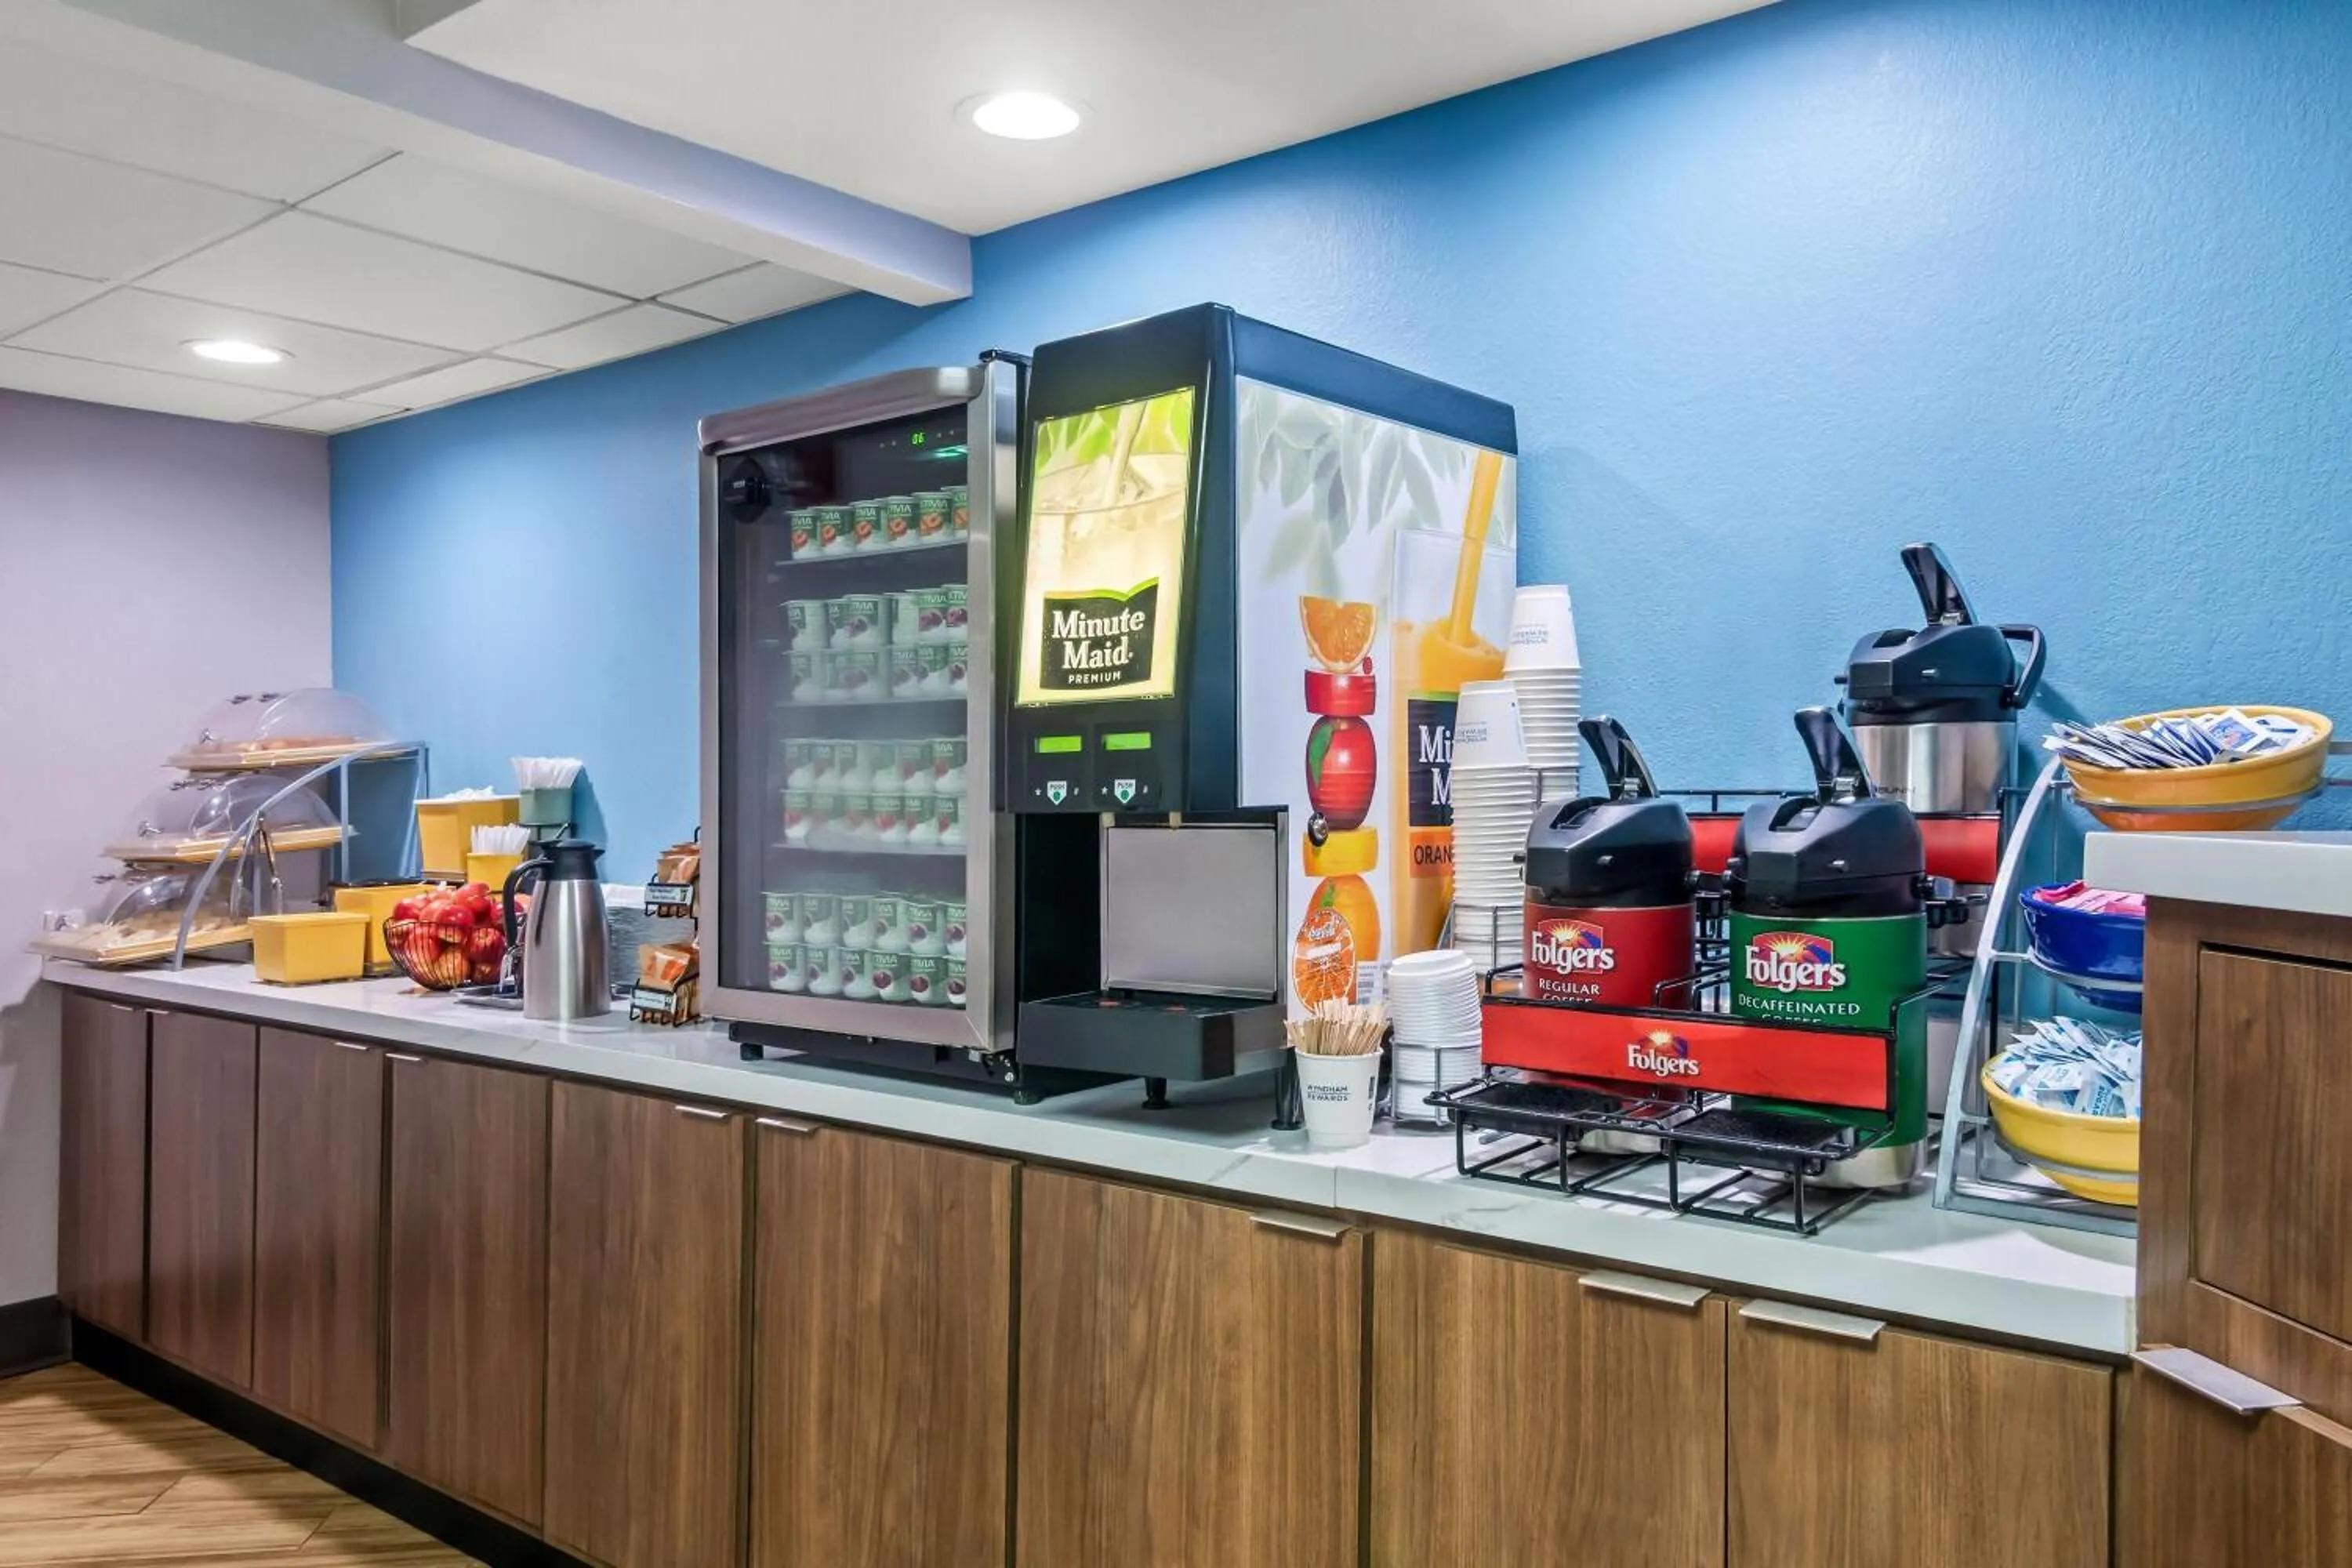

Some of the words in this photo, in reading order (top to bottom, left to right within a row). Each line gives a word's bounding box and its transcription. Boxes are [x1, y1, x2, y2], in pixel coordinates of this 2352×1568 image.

[1051, 607, 1146, 640] Minute
[1062, 636, 1130, 669] Maid
[1068, 670, 1122, 684] PREMIUM
[1414, 844, 1453, 866] ORAN
[1531, 931, 1615, 975] Folgers
[1744, 945, 1847, 993] Folgers
[1539, 978, 1599, 995] REGULAR
[1738, 993, 1861, 1016] DECAFFEINATED
[1627, 1044, 1700, 1077] Folgers
